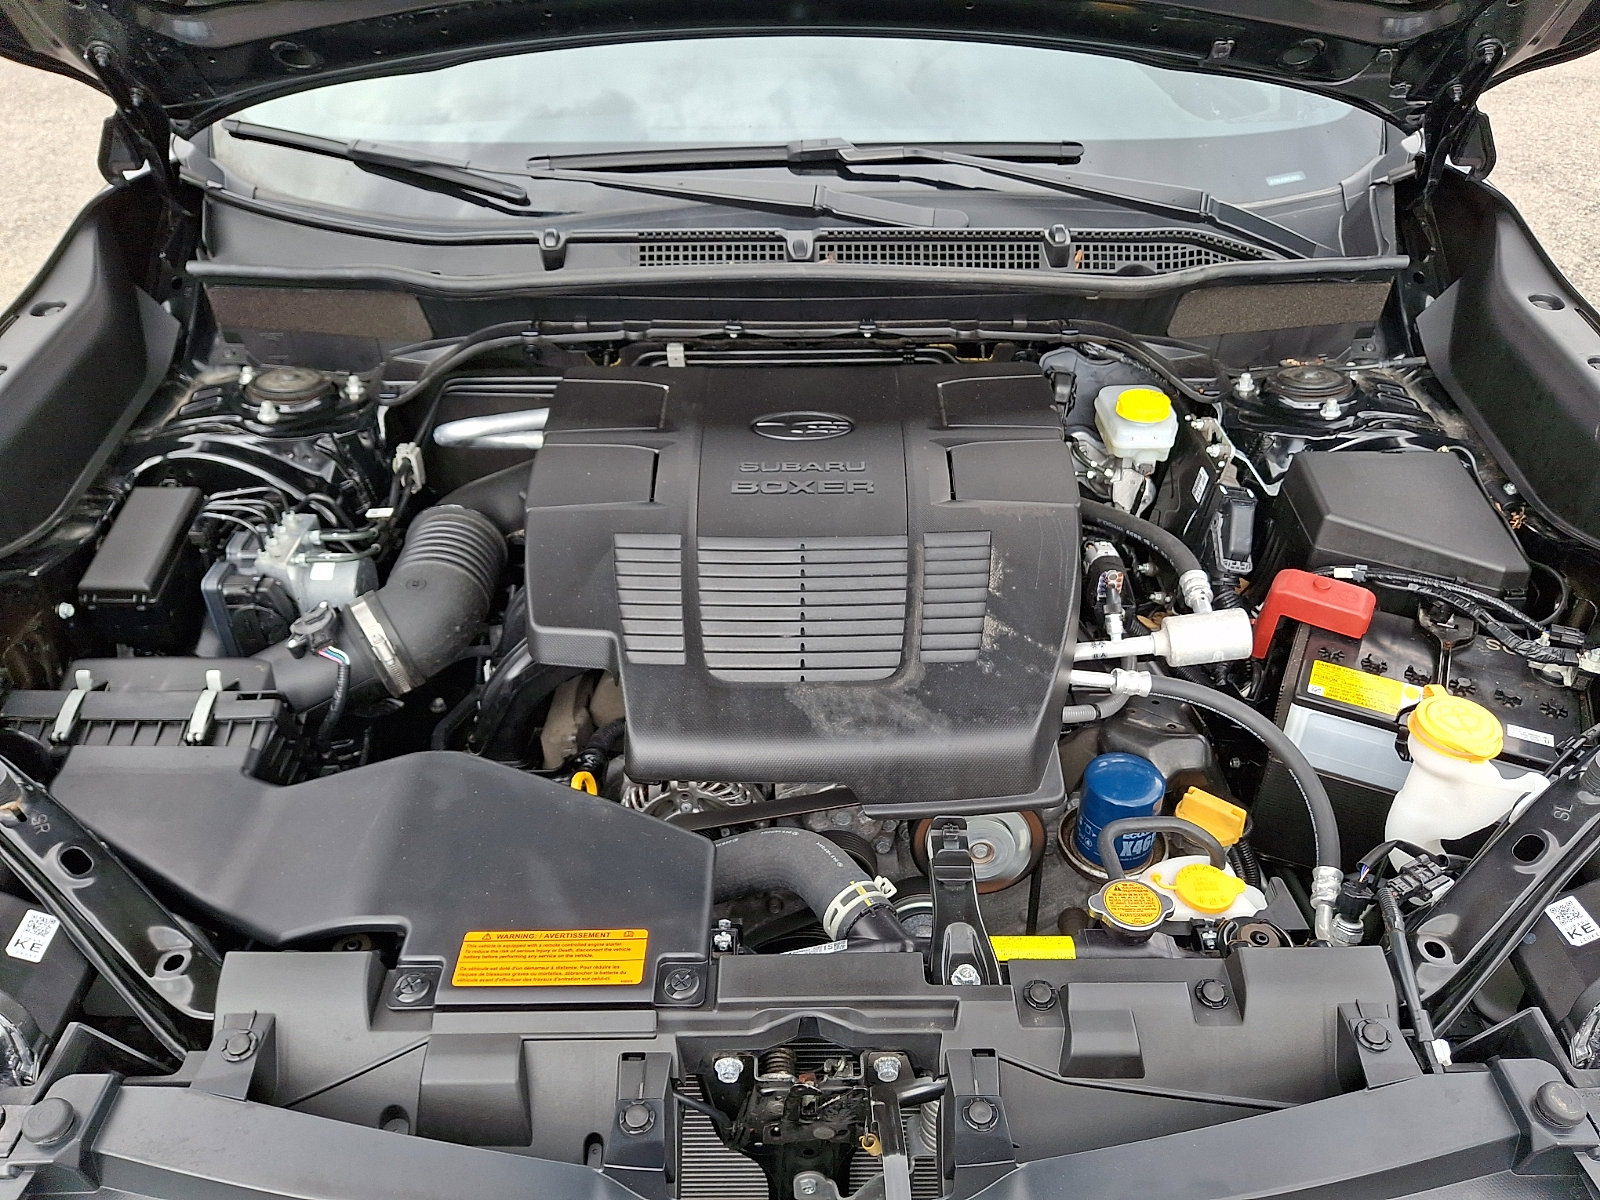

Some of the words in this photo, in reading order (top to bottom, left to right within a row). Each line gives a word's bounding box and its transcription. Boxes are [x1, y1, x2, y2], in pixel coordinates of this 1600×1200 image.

[739, 461, 866, 473] SUBARU
[731, 480, 875, 495] BOXER
[1554, 804, 1573, 822] SL
[1566, 922, 1596, 940] KE
[14, 938, 42, 953] KE
